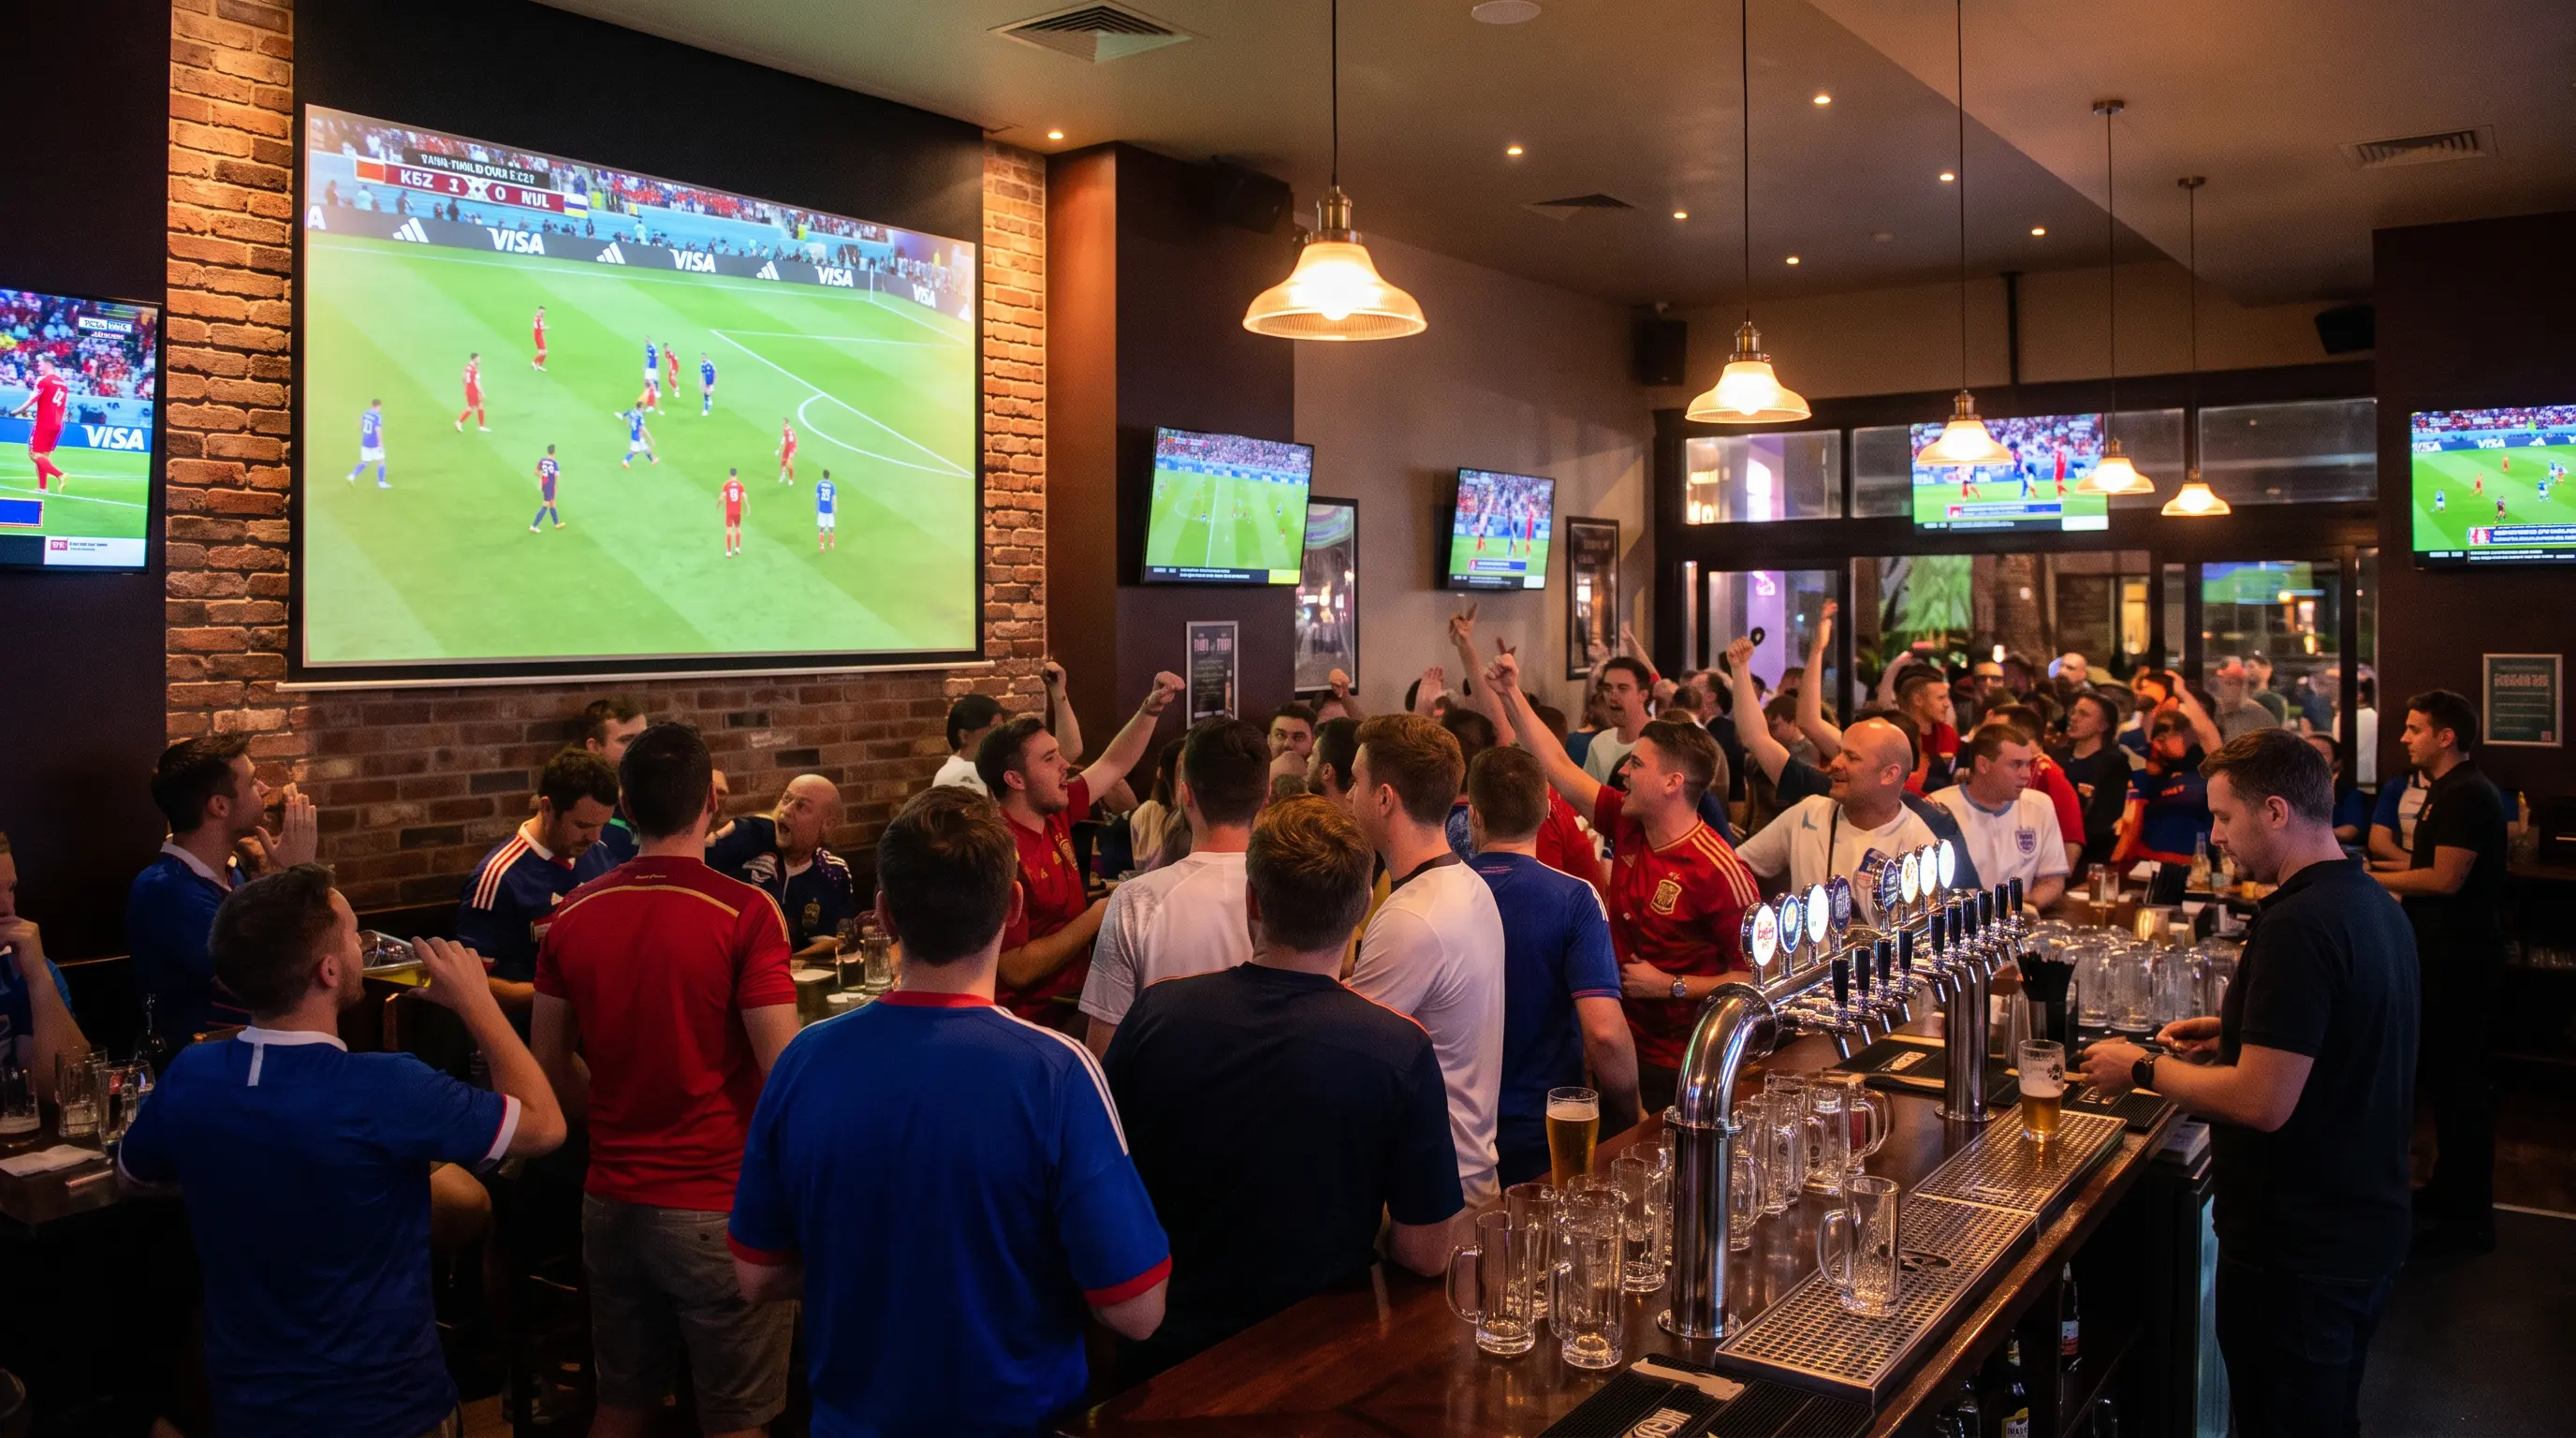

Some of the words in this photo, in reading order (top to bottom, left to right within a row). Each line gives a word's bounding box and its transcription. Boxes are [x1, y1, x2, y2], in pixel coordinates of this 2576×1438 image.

[448, 178, 460, 193] 1
[486, 227, 545, 255] VISA
[669, 248, 716, 273] VISA
[814, 265, 854, 287] VISA
[80, 424, 145, 450] VISA
